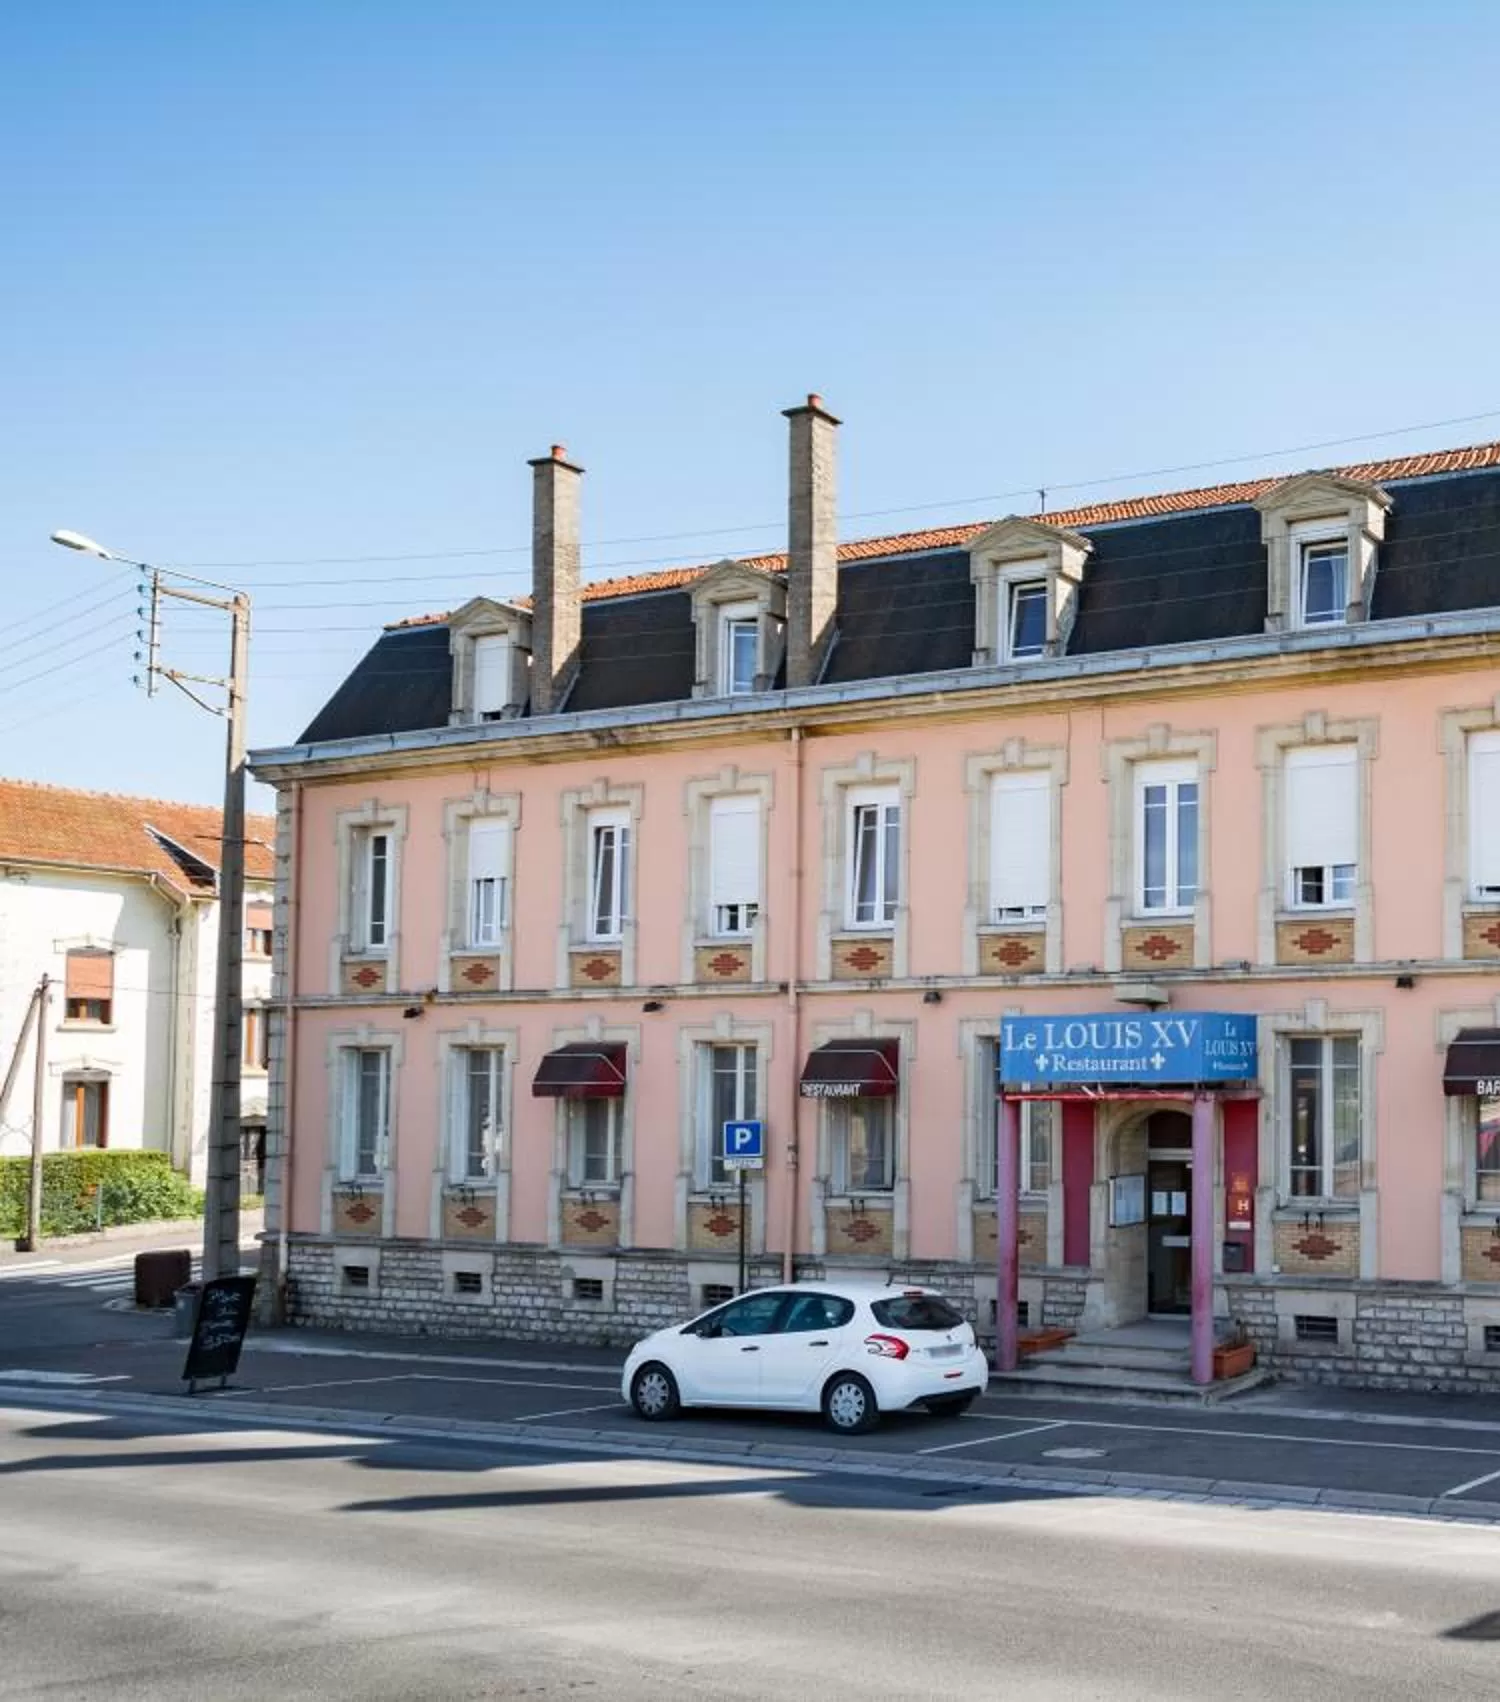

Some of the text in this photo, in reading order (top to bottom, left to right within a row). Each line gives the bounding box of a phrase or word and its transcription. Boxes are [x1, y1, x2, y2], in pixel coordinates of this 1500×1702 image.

[1005, 1019, 1198, 1050] Le LOUIS XV
[1204, 1040, 1256, 1056] LOUIS XV
[1052, 1054, 1148, 1072] Restaurant
[802, 1083, 860, 1097] RESTAURANT
[735, 1128, 752, 1150] P
